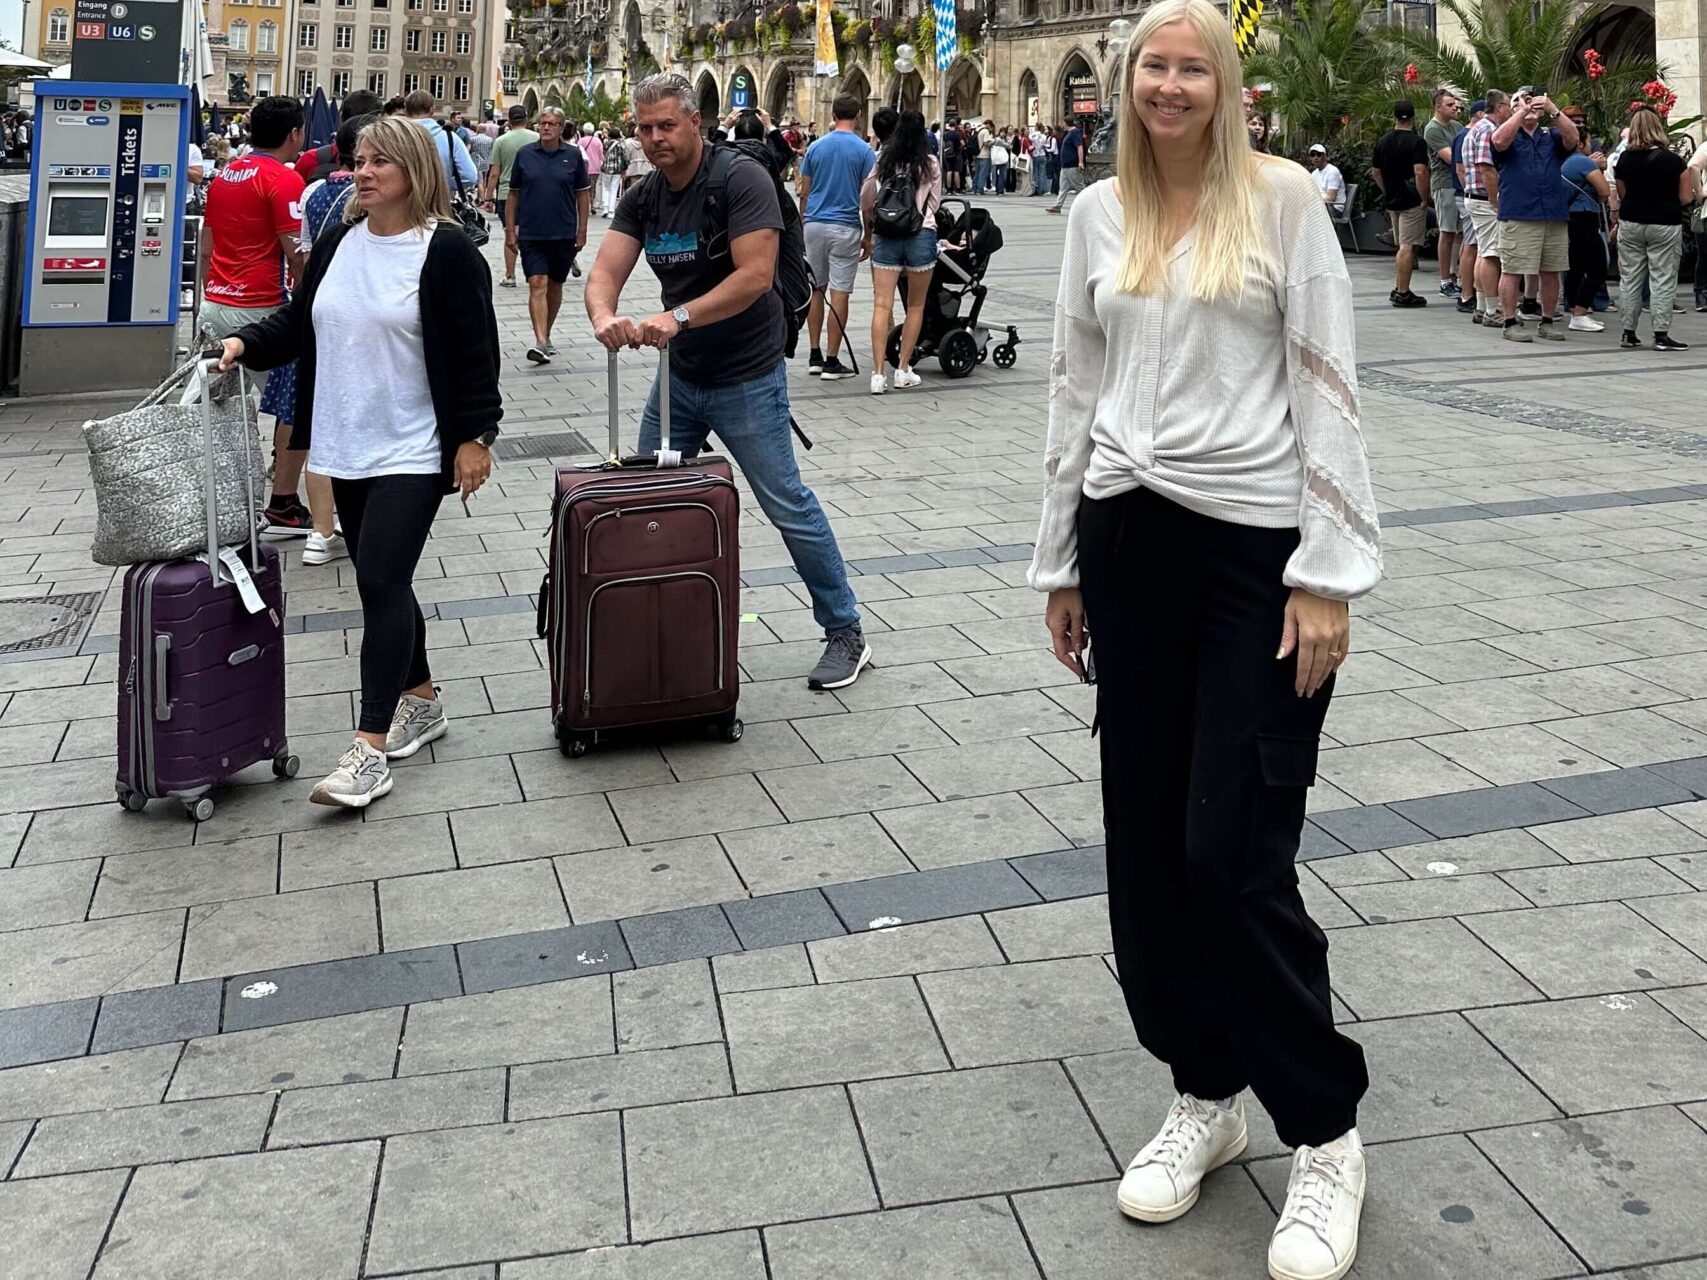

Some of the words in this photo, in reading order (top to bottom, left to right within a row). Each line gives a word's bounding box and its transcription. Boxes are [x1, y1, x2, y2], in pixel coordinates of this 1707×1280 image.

[77, 11, 106, 19] Entrance
[78, 1, 107, 10] Eingang
[115, 6, 124, 16] D
[82, 25, 100, 36] U3
[112, 26, 131, 38] U6
[141, 26, 153, 39] S
[736, 76, 746, 89] S
[56, 100, 65, 109] U
[100, 100, 110, 110] S
[485, 100, 493, 110] S
[735, 92, 745, 105] U
[121, 128, 137, 176] Tickets
